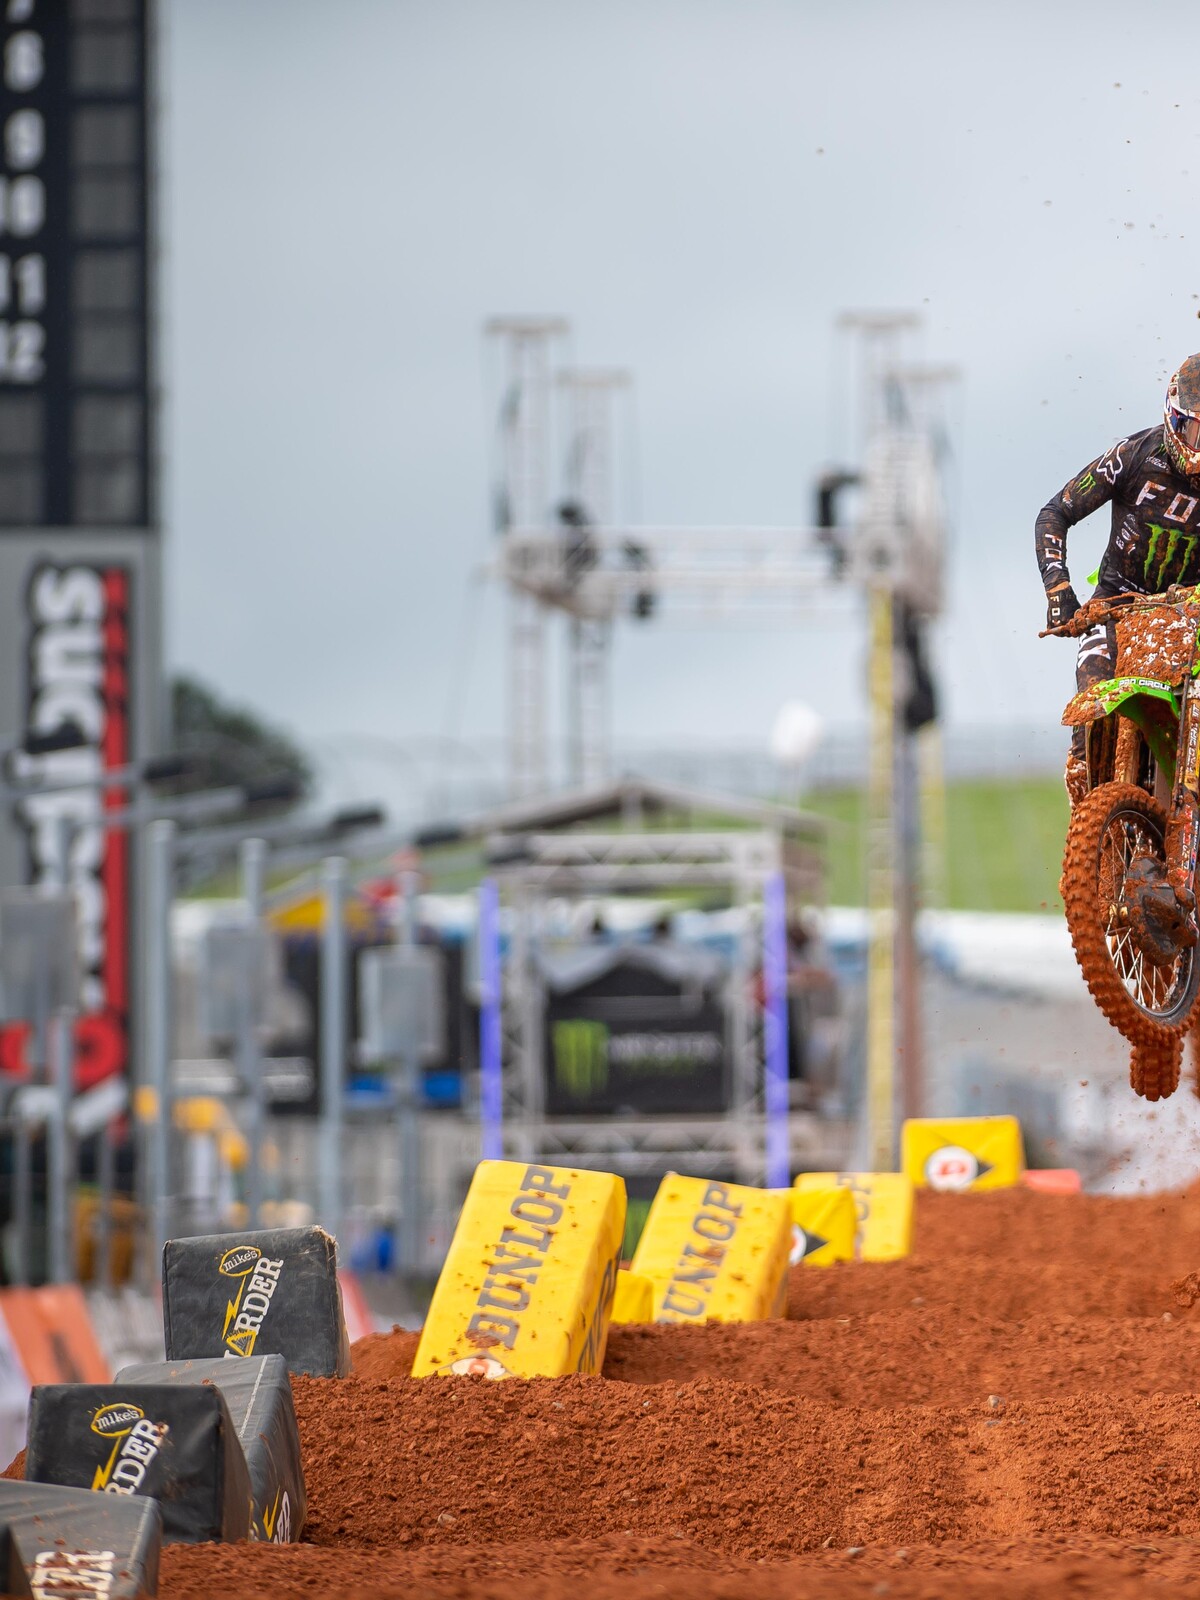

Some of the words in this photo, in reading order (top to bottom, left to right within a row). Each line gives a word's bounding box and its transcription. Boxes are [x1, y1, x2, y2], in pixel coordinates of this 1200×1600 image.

[1045, 533, 1063, 572] FOX
[1138, 679, 1171, 692] CIRCUI
[222, 1249, 259, 1273] mike's
[465, 1165, 572, 1351] DUNLOP
[656, 1181, 744, 1324] UNLOP
[96, 1408, 141, 1431] mike's
